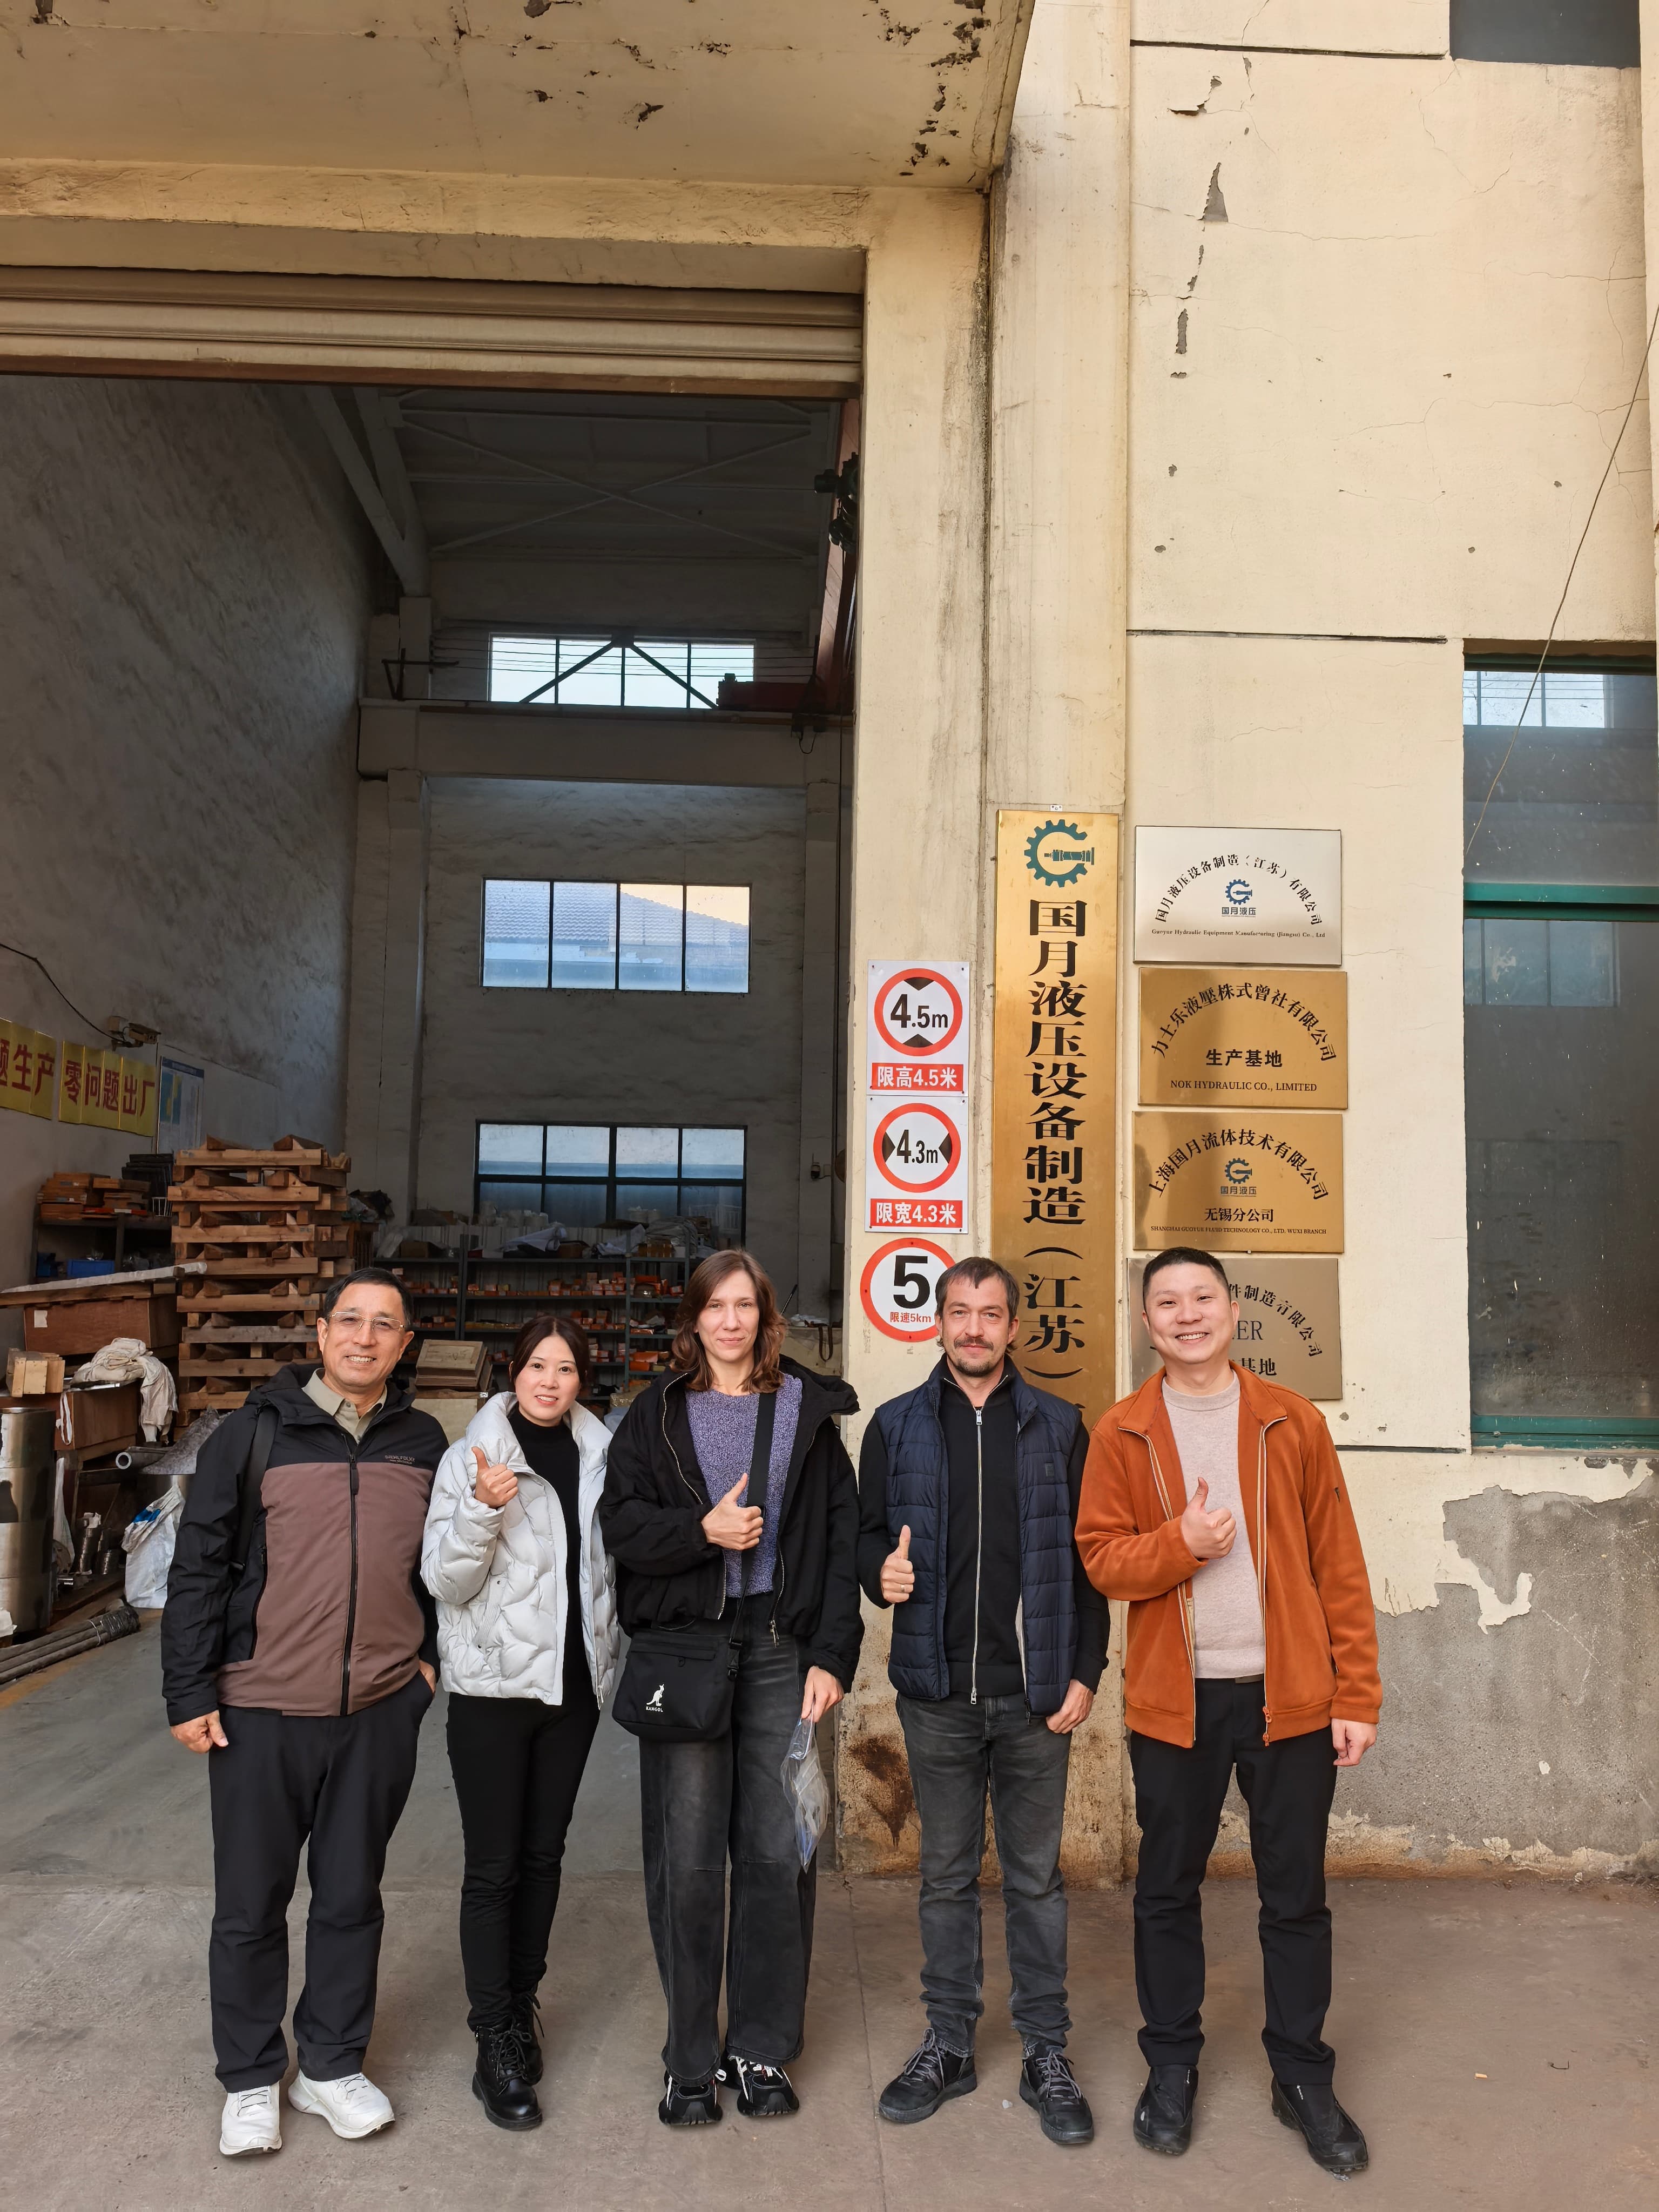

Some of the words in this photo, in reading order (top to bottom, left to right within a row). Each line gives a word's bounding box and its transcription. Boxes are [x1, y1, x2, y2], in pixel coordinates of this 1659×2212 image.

[1222, 907, 1256, 915] 国月液压
[891, 994, 948, 1028] 4.5m
[1206, 1049, 1283, 1067] 生产基地
[64, 1060, 155, 1117] 零问题出厂
[877, 1065, 957, 1089] 限高4.5米
[1170, 1080, 1192, 1088] NOK
[1194, 1081, 1252, 1090] HYDRAULIC
[1254, 1082, 1273, 1091] CO.,
[1276, 1083, 1317, 1091] LIMITED
[896, 1129, 938, 1164] 4.3m
[1022, 900, 1087, 1408] 国月液压设备制造（江苏）
[1149, 1129, 1328, 1200] 上海国月流体技术有限公司
[1220, 1186, 1257, 1195] 国月液压
[876, 1202, 956, 1225] 限宽4.3米
[1204, 1208, 1273, 1222] 无锡分公司
[893, 1255, 930, 1309] 5
[890, 1311, 931, 1323] 限速5km
[1229, 1283, 1323, 1357] 件制造有限公司
[1232, 1320, 1263, 1340] ER
[1233, 1358, 1277, 1376] 基地
